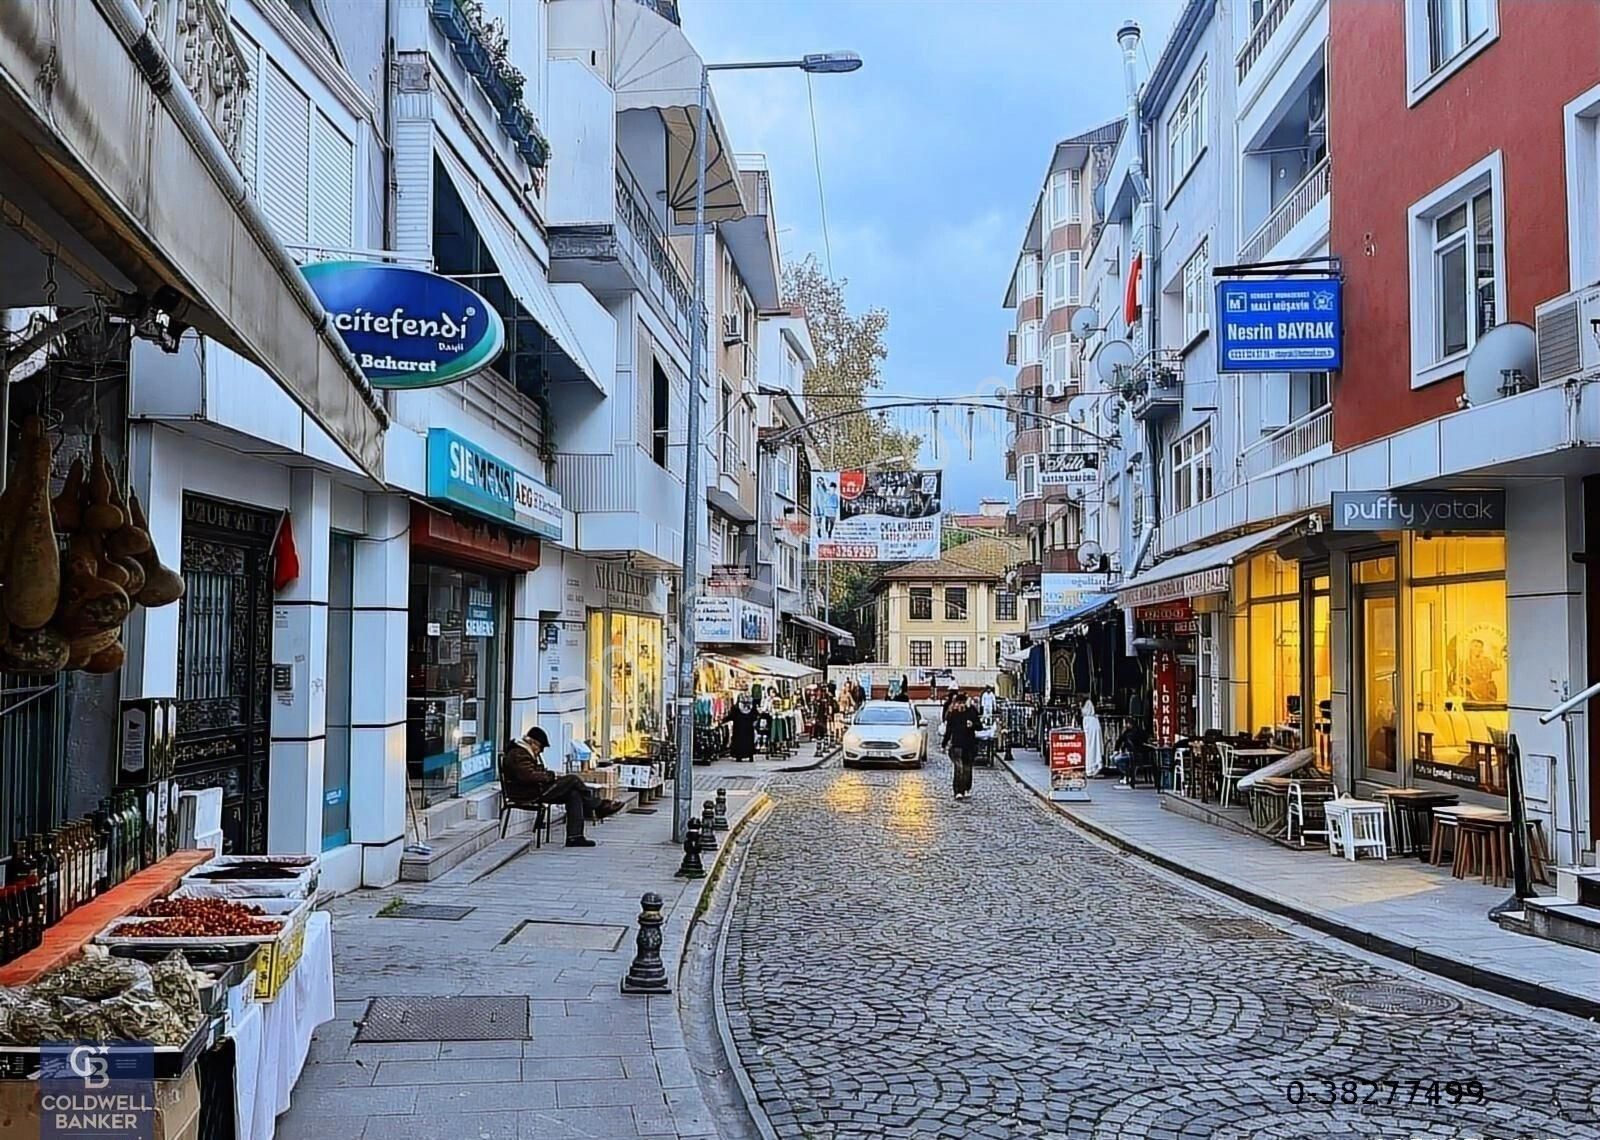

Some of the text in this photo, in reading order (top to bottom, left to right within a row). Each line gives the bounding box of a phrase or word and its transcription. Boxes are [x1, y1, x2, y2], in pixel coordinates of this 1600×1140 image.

[1227, 321, 1335, 340] Nesrin BAYRAK
[361, 354, 437, 372] Baharat
[450, 441, 511, 502] SIEMENS
[515, 481, 532, 508] AEG
[1344, 497, 1493, 526] puffy yatak
[465, 619, 494, 637] SIEMENS
